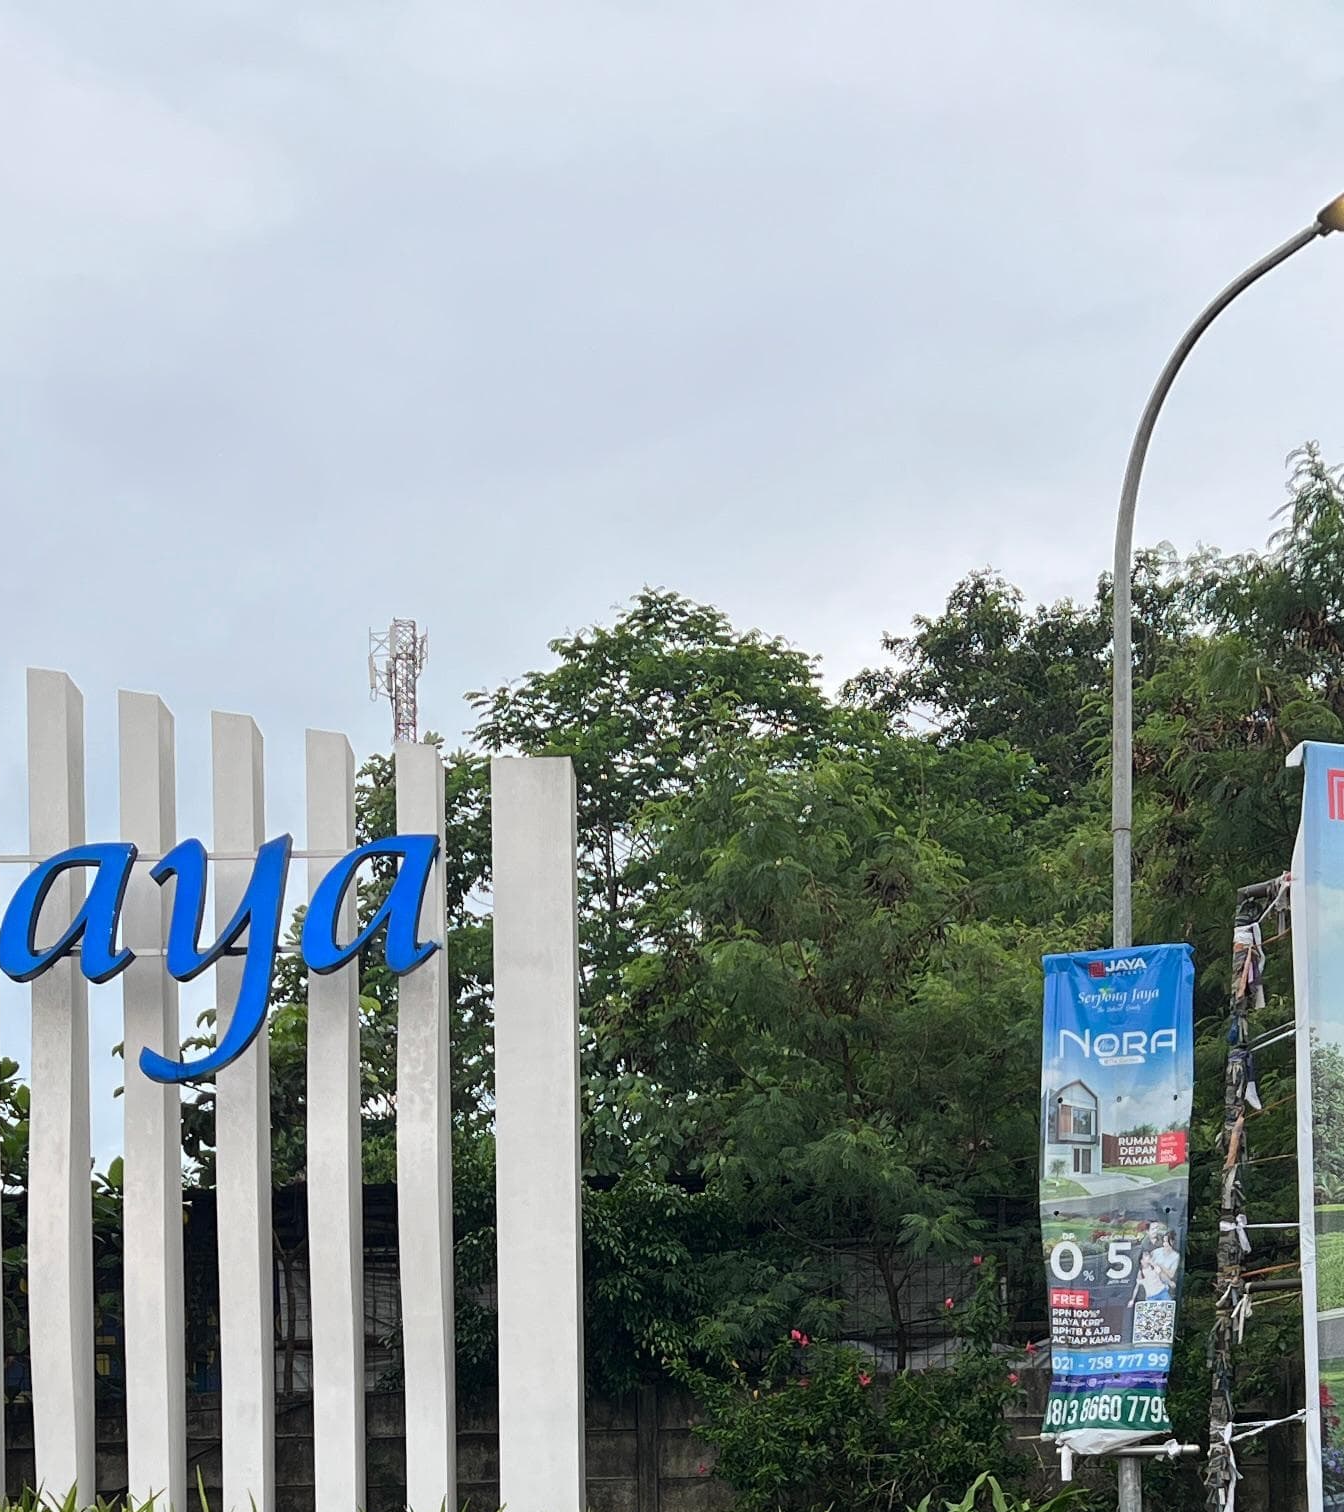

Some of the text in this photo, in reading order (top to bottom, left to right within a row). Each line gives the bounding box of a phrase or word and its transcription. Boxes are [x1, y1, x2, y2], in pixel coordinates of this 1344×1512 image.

[1105, 957, 1147, 973] JAYA
[1078, 988, 1159, 1007] Serpong Jaya
[1060, 1028, 1176, 1058] NORA
[1120, 1146, 1156, 1156] DEPAN
[1118, 1155, 1156, 1166] TAMAN
[1106, 1242, 1133, 1279] 5
[1052, 1294, 1084, 1306] FREE
[1052, 1309, 1072, 1317] PPN
[1052, 1318, 1079, 1326] BIAYA
[1085, 1328, 1092, 1336] &
[1052, 1336, 1066, 1344] AC
[1089, 1335, 1121, 1344] KAMAR
[1052, 1357, 1073, 1370] 021
[1088, 1356, 1113, 1370] 758
[1117, 1354, 1144, 1368] 777
[1148, 1353, 1168, 1367] 99
[1080, 1395, 1121, 1422] 8660
